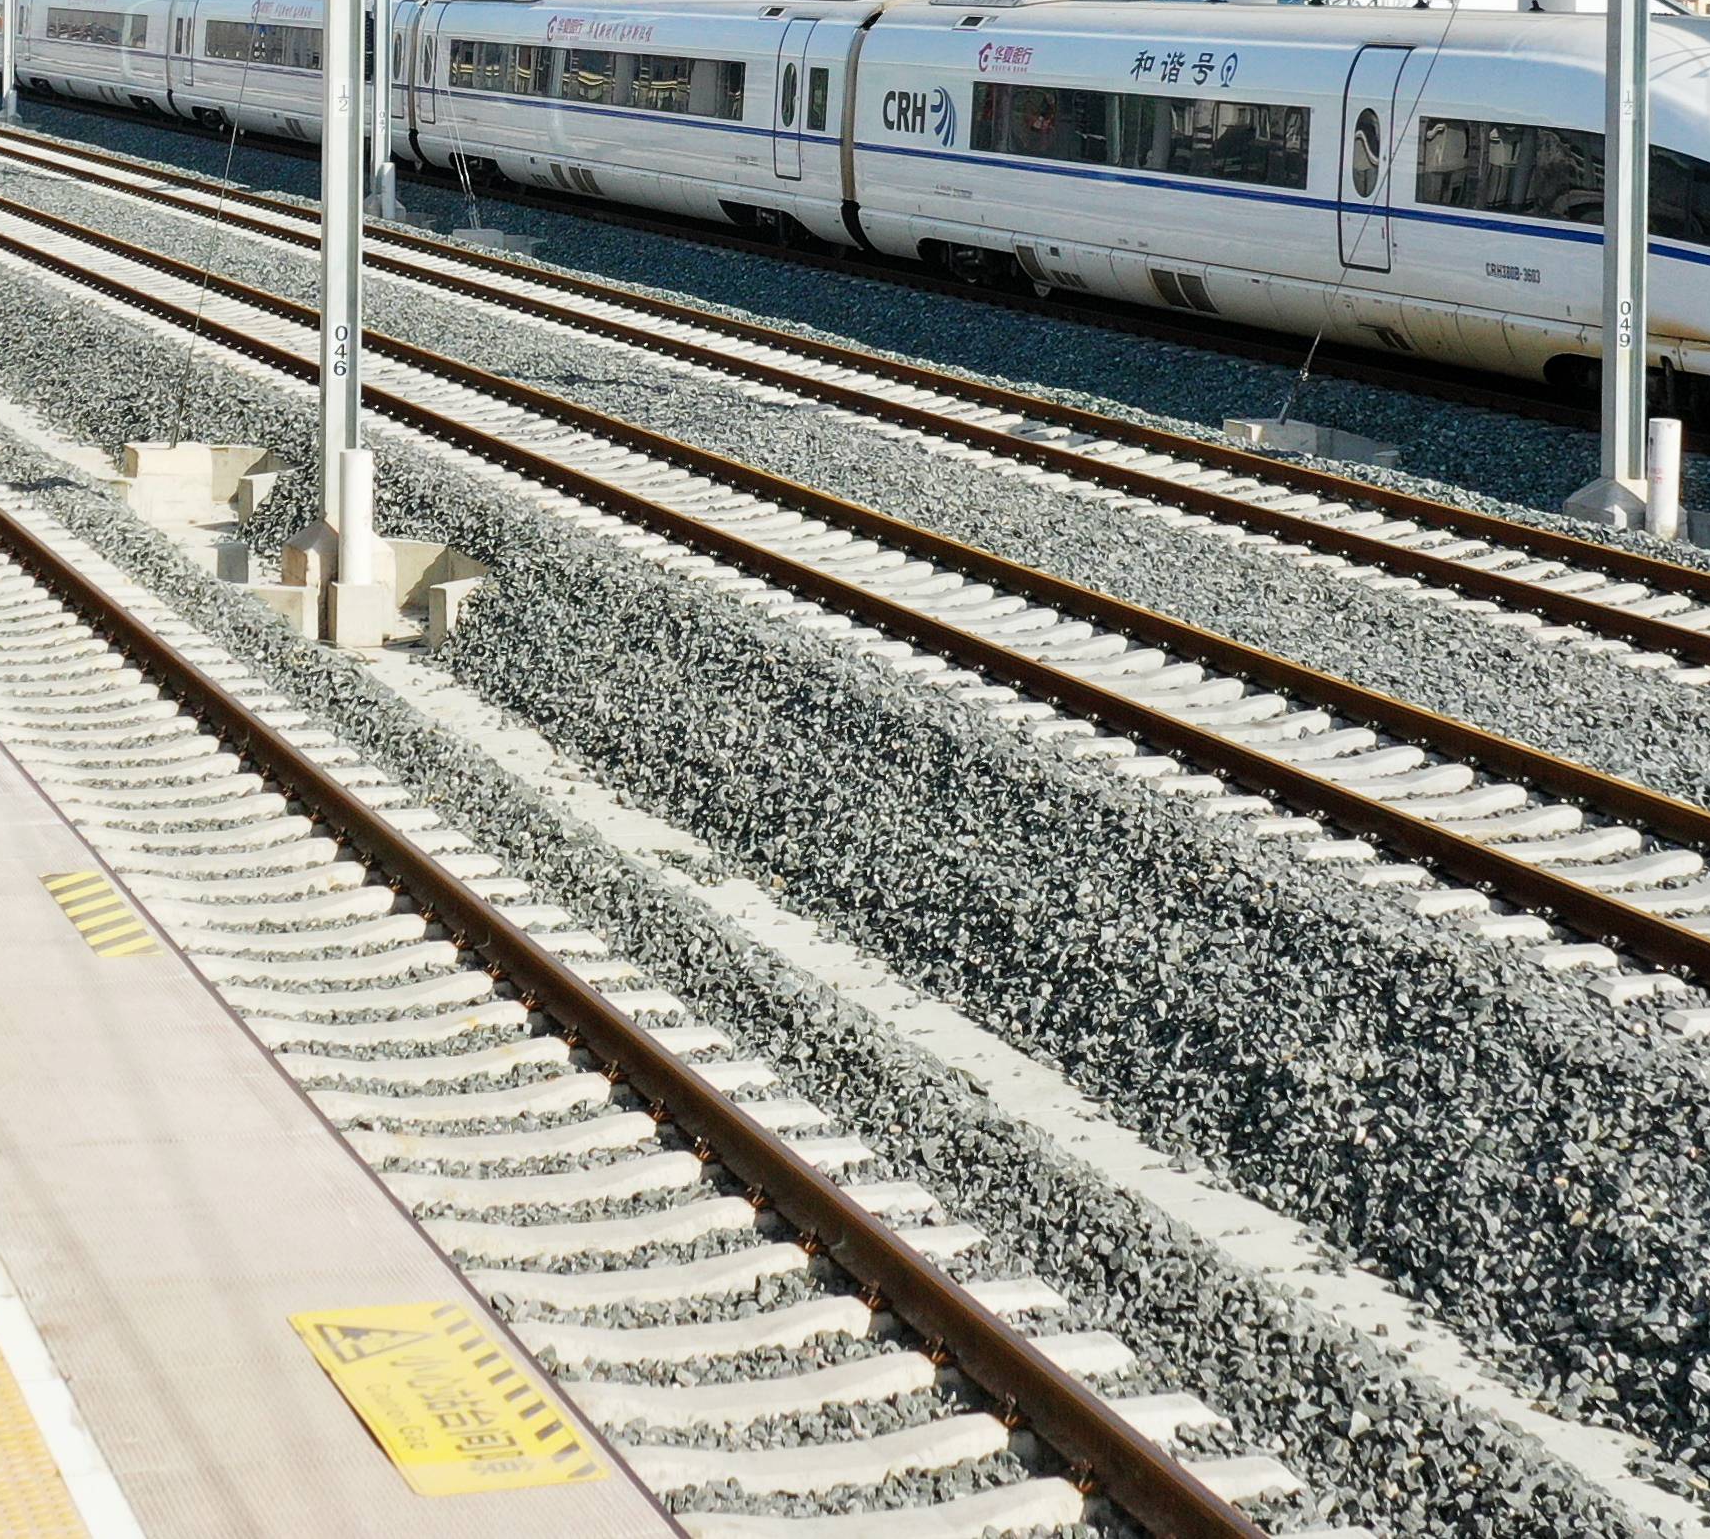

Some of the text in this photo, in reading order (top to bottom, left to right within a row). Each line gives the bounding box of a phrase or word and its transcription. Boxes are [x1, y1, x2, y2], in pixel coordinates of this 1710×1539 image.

[993, 46, 1034, 65] 华夏银行
[1129, 49, 1216, 86] 和谐号
[882, 90, 927, 134] CRH
[1619, 301, 1632, 348] 049
[334, 325, 349, 377] 046
